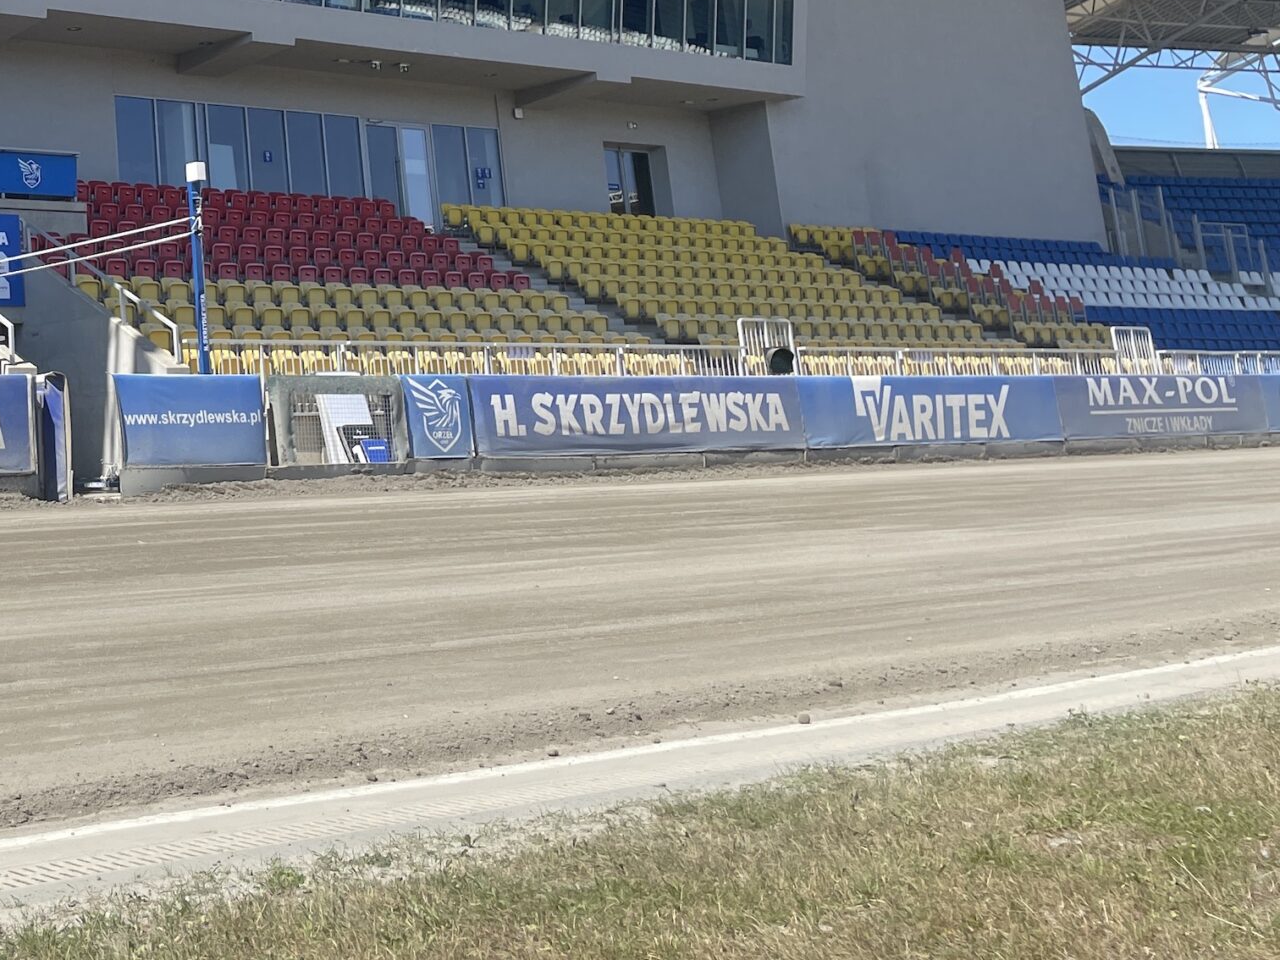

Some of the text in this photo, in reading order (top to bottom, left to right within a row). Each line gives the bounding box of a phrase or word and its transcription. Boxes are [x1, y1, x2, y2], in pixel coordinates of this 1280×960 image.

[1086, 376, 1236, 406] MAX-POL
[124, 409, 262, 428] www.skrzydlewska.pl
[490, 391, 791, 437] H. SKRZYDLEWSKA
[865, 384, 1011, 441] VARITEX
[1126, 417, 1163, 433] ZNICZE
[1169, 415, 1213, 431] WKŁADY
